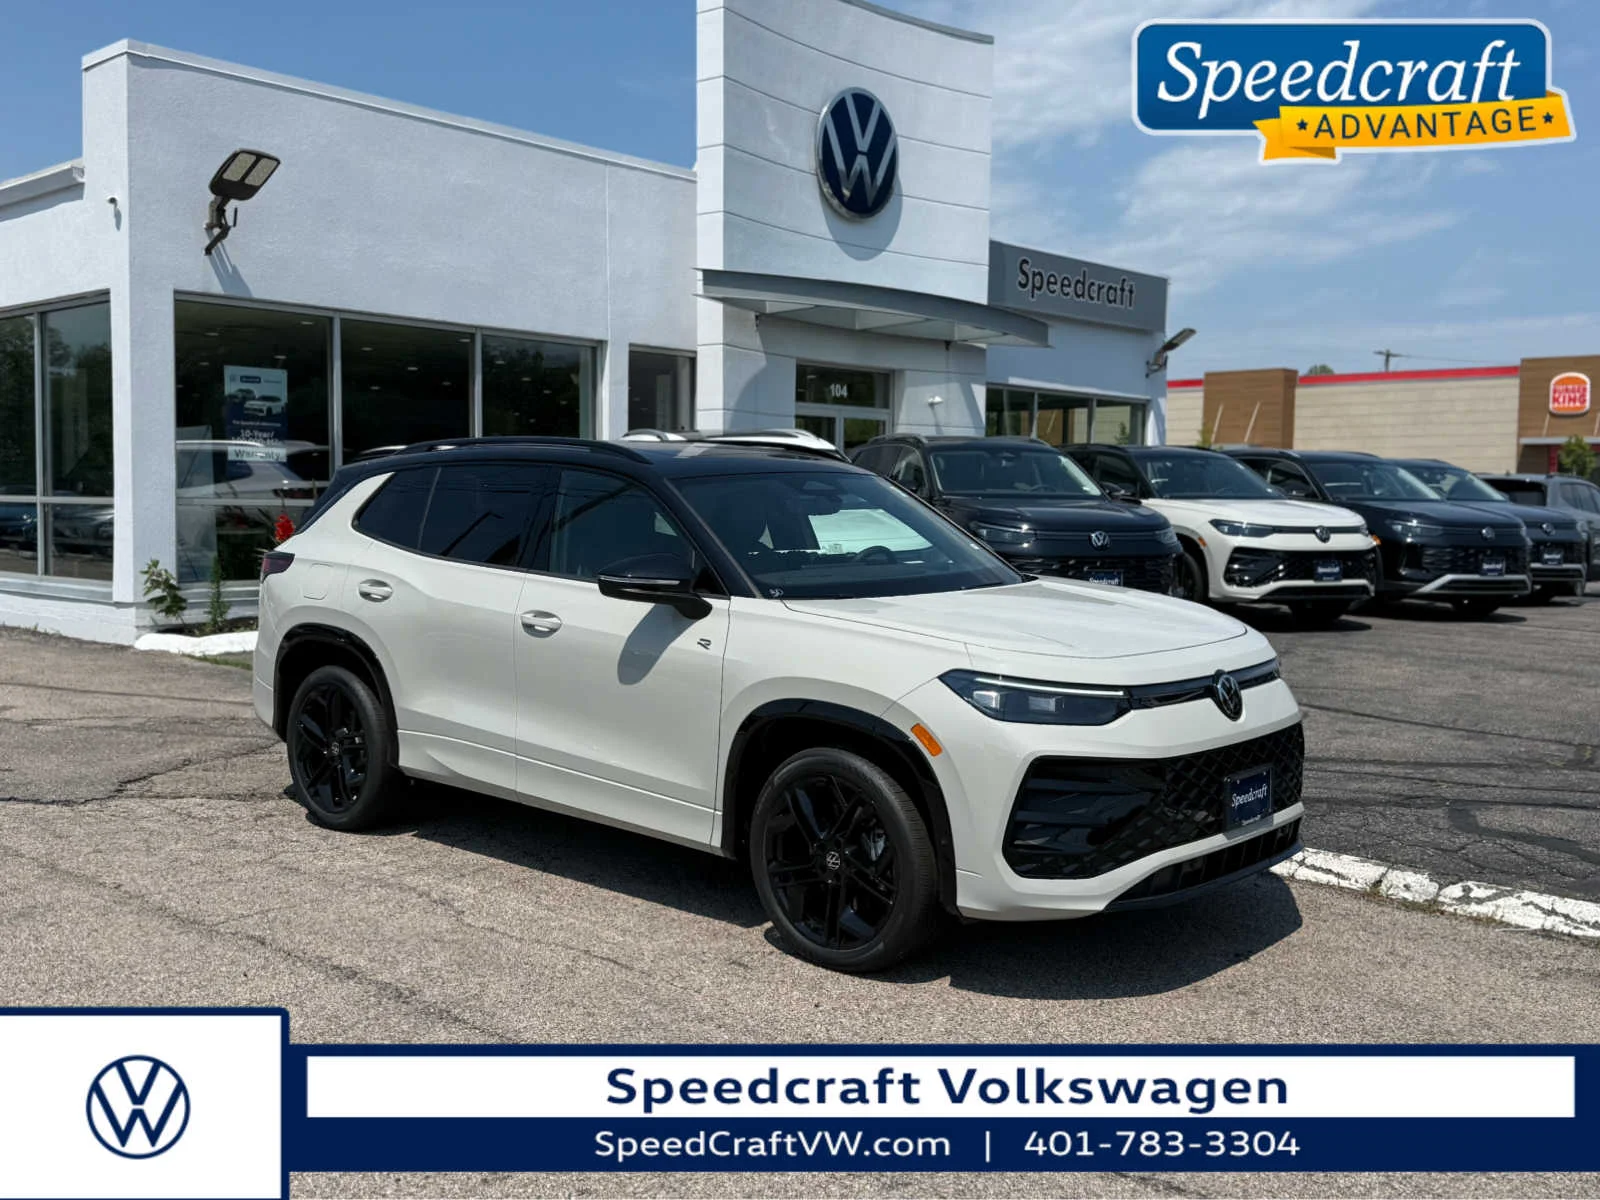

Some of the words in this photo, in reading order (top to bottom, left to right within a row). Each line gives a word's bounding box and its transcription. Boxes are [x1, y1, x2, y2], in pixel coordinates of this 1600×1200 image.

[1017, 257, 1135, 309] Speedcraft
[829, 383, 849, 398] 104
[1231, 783, 1268, 809] Speedcraft
